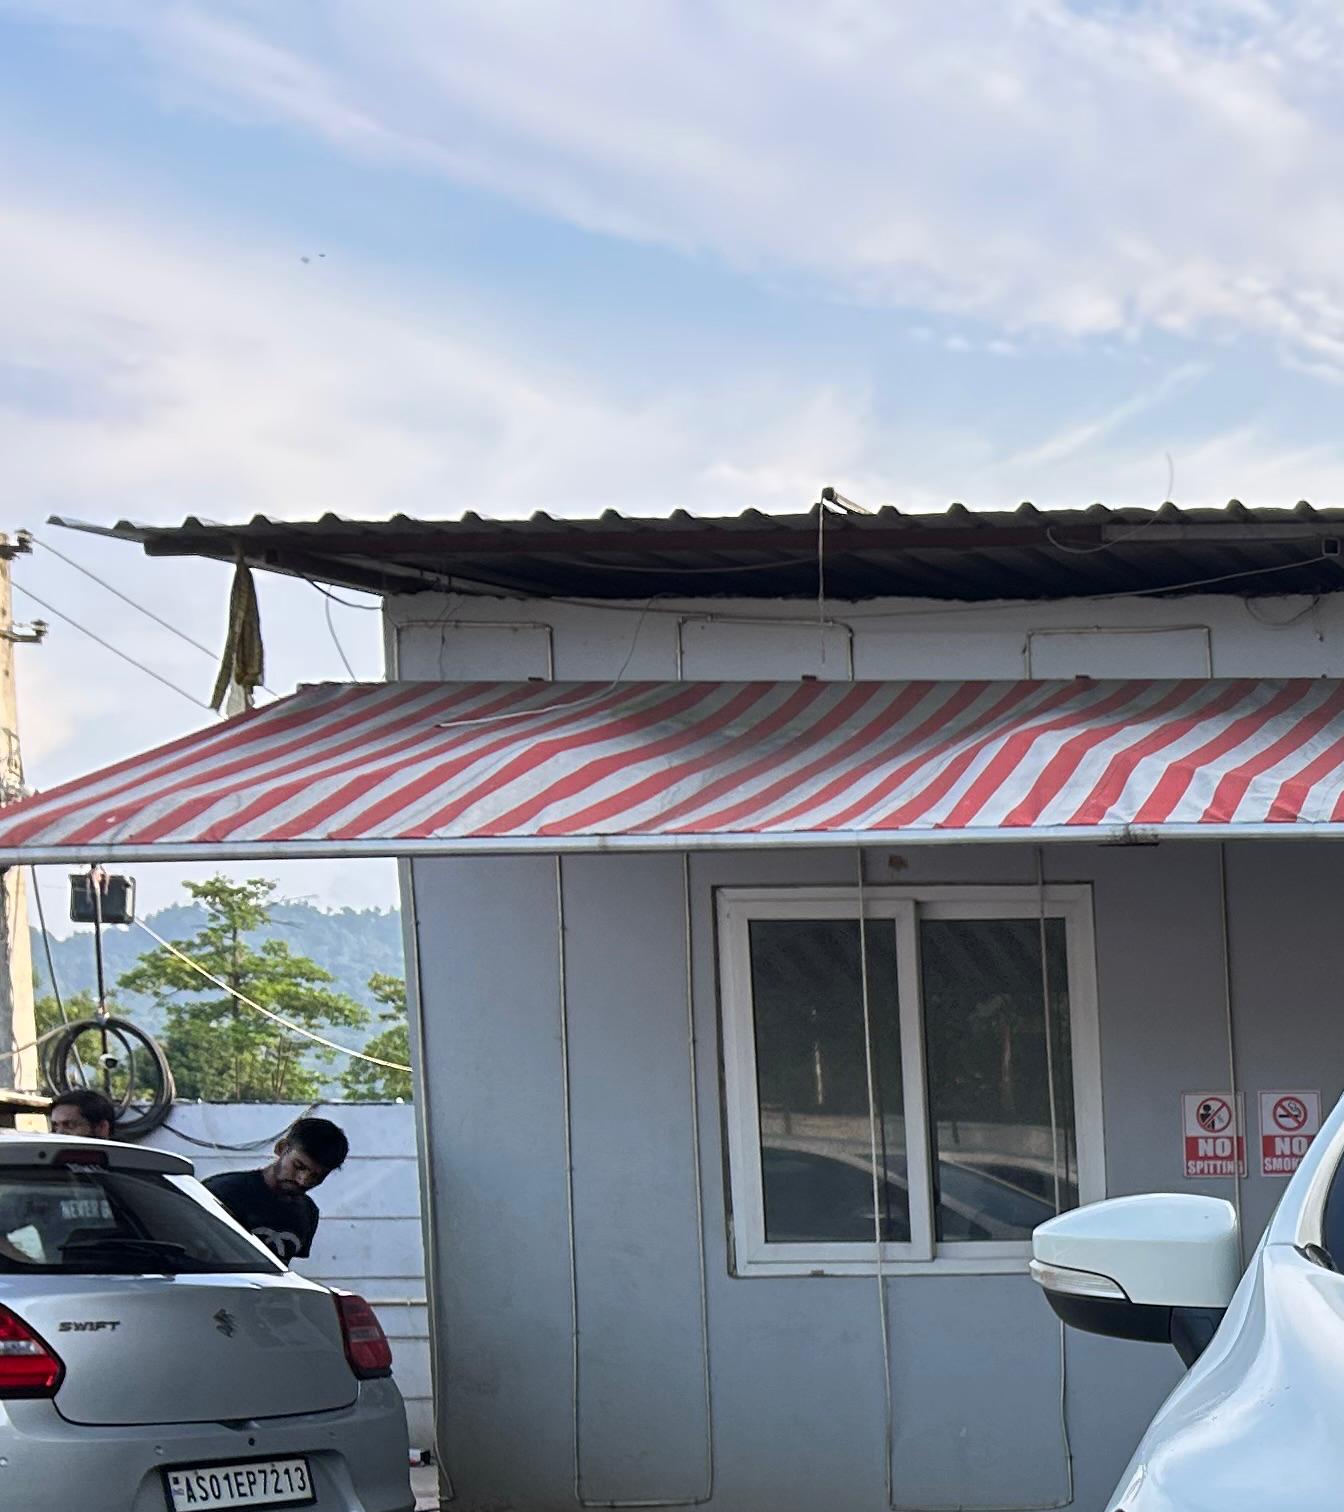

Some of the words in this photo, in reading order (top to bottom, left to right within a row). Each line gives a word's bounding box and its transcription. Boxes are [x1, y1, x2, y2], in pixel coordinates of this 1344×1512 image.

[1198, 1138, 1232, 1157] NO
[1274, 1136, 1309, 1156] NO
[1264, 1157, 1300, 1172] SMOK
[59, 1321, 120, 1332] SWIFT
[184, 1465, 307, 1503] AS01EP7213
